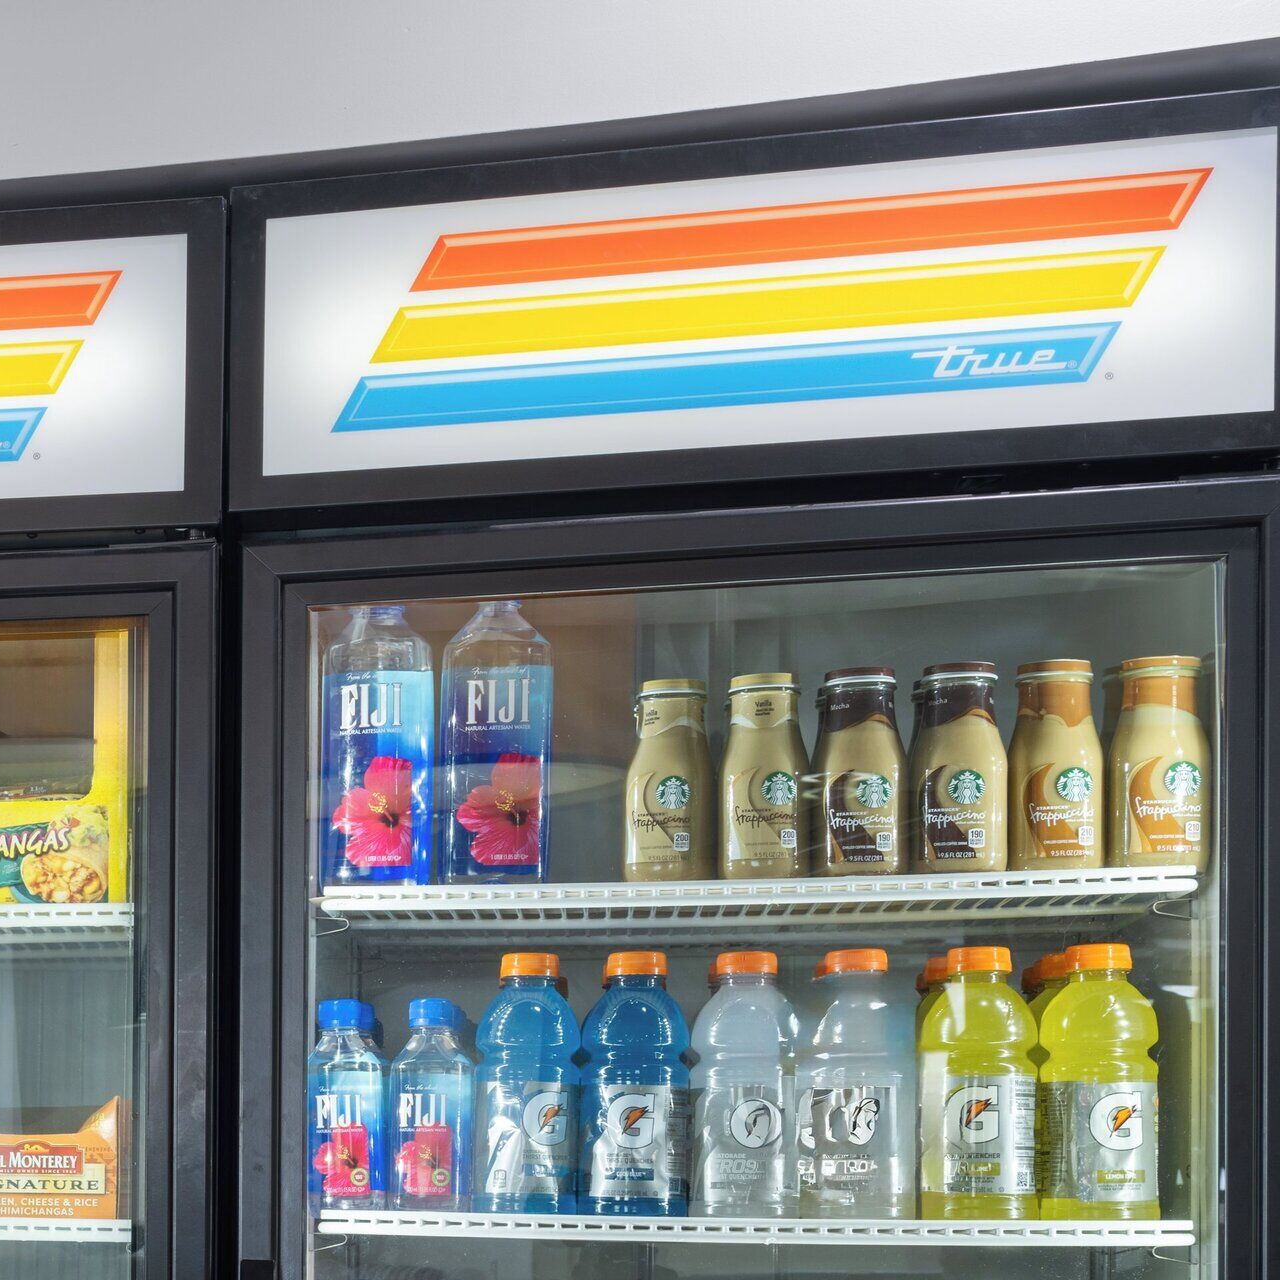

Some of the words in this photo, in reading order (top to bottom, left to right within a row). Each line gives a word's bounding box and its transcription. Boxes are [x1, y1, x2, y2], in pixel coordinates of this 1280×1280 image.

[911, 344, 1066, 379] true
[340, 683, 402, 730] FIJI
[466, 678, 530, 725] FIJI
[829, 809, 896, 830] frappuccino
[608, 1093, 656, 1149] G
[9, 1151, 77, 1168] MONTEREY
[20, 1198, 60, 1206] CHEESE
[63, 1198, 72, 1206] &
[74, 1198, 98, 1206] RICE
